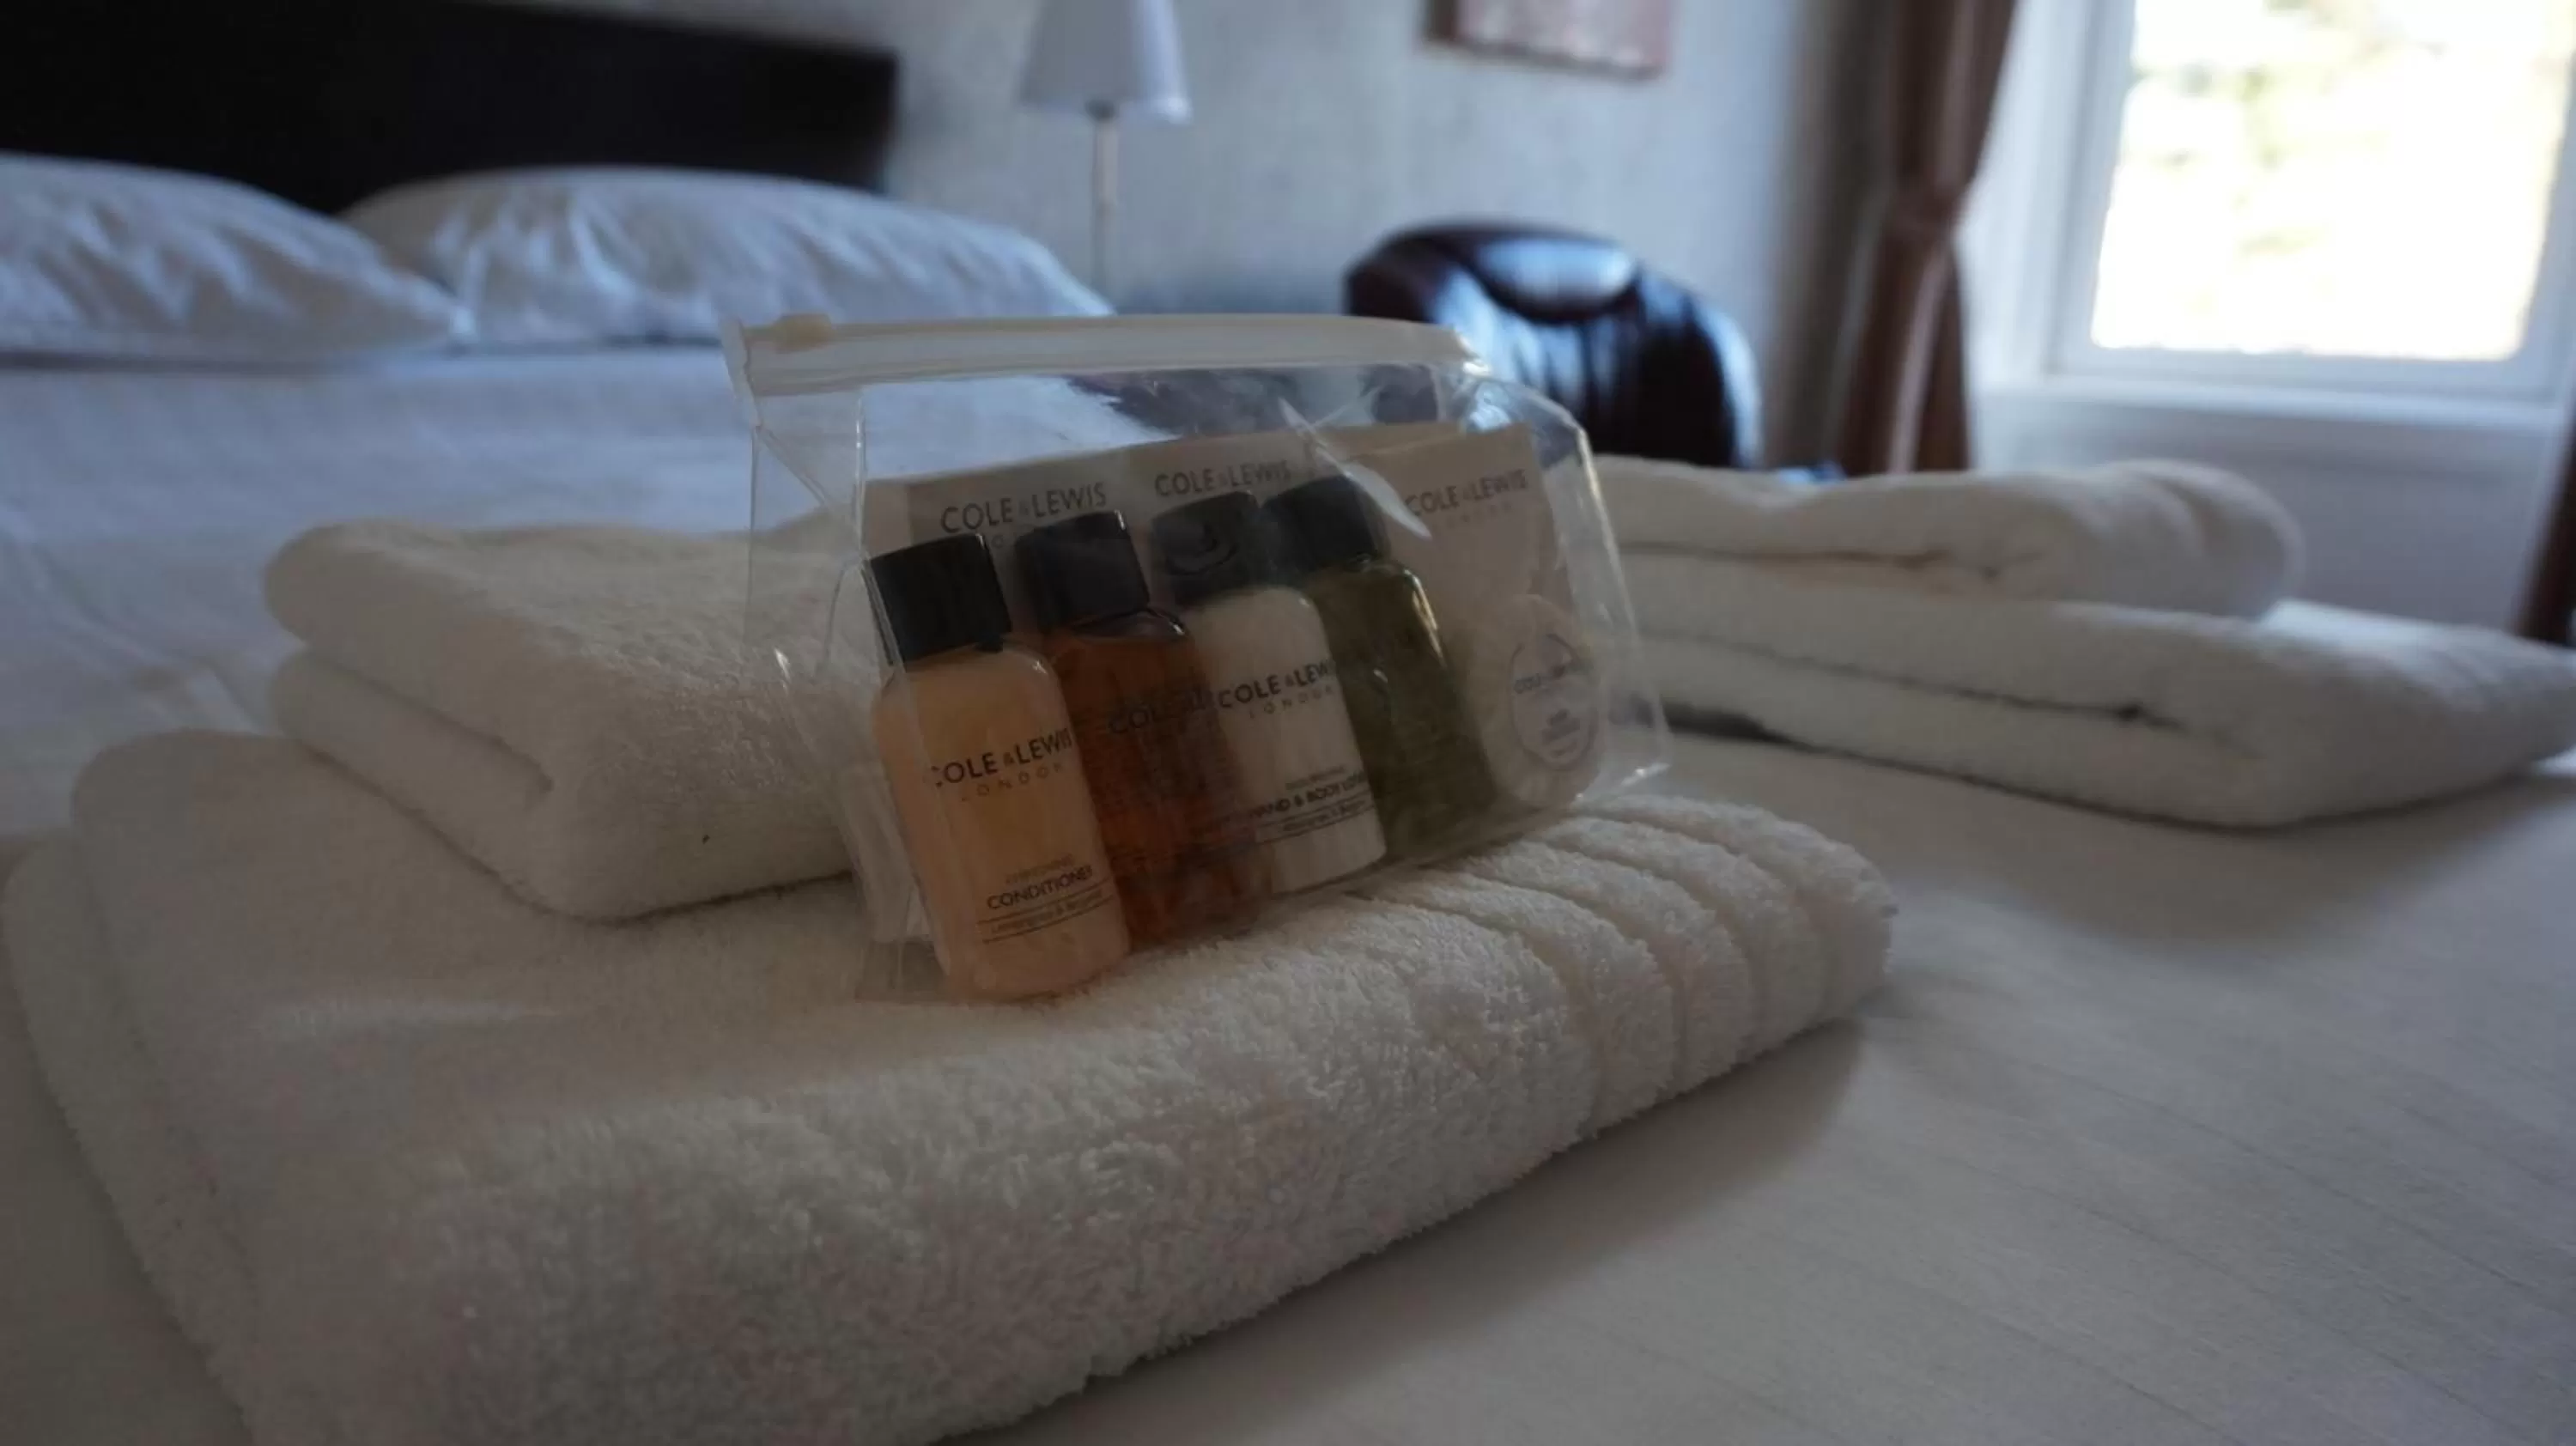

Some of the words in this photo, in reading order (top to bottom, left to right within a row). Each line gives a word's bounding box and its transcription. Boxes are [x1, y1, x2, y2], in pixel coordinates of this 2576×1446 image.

[1154, 467, 1216, 497] COLE
[940, 497, 1013, 533] COLE
[1031, 481, 1107, 519] LEWIS
[1218, 675, 1282, 708] COLE
[960, 761, 1062, 803] ONDON
